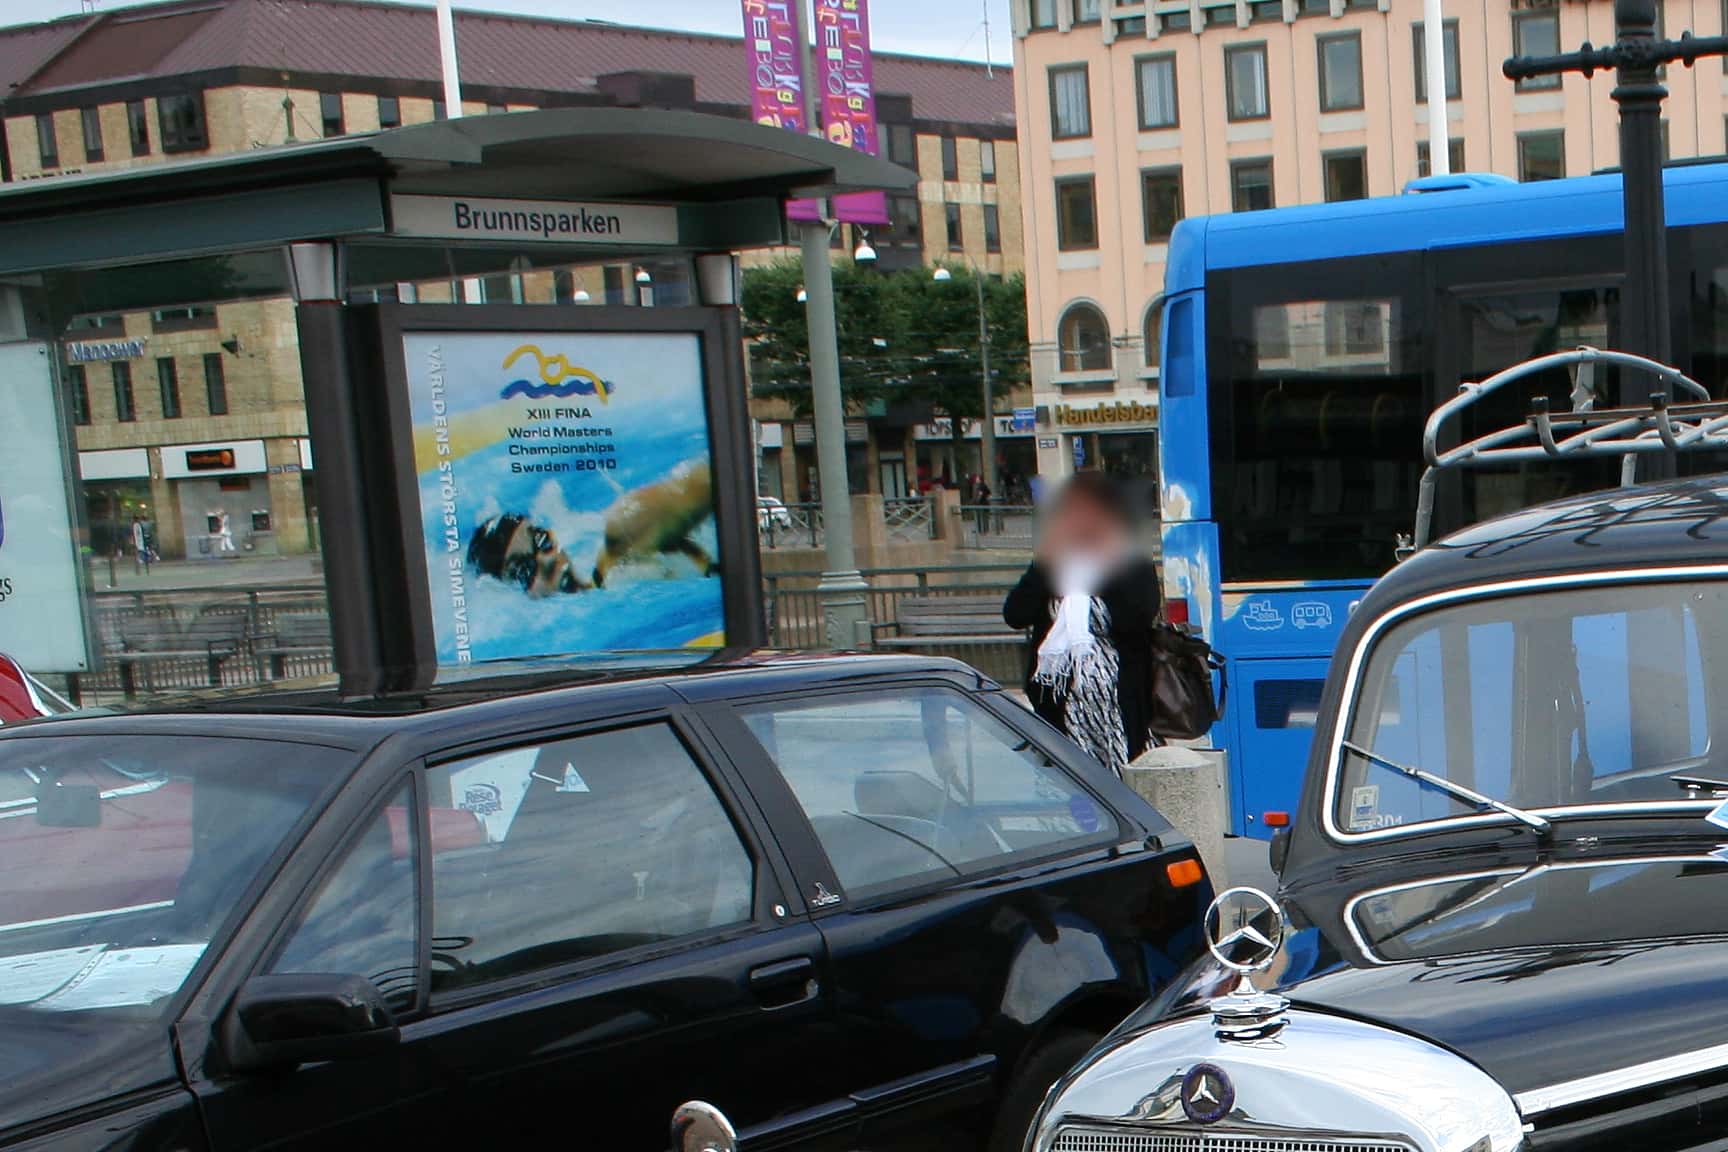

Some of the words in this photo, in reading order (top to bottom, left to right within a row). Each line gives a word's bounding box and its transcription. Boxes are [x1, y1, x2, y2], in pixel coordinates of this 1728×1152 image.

[454, 202, 621, 237] Brunnsparken
[528, 408, 551, 420] XIII
[555, 407, 592, 419] FINA
[1055, 400, 1158, 425] Handelsba
[508, 427, 550, 439] World
[553, 427, 613, 438] Masters
[508, 442, 616, 456] Championships
[511, 461, 570, 474] Sweden
[575, 458, 617, 471] 2010
[426, 345, 450, 455] VÄRLDENS
[438, 458, 460, 553] STÖRSTA
[449, 559, 472, 664] SIMEVENE
